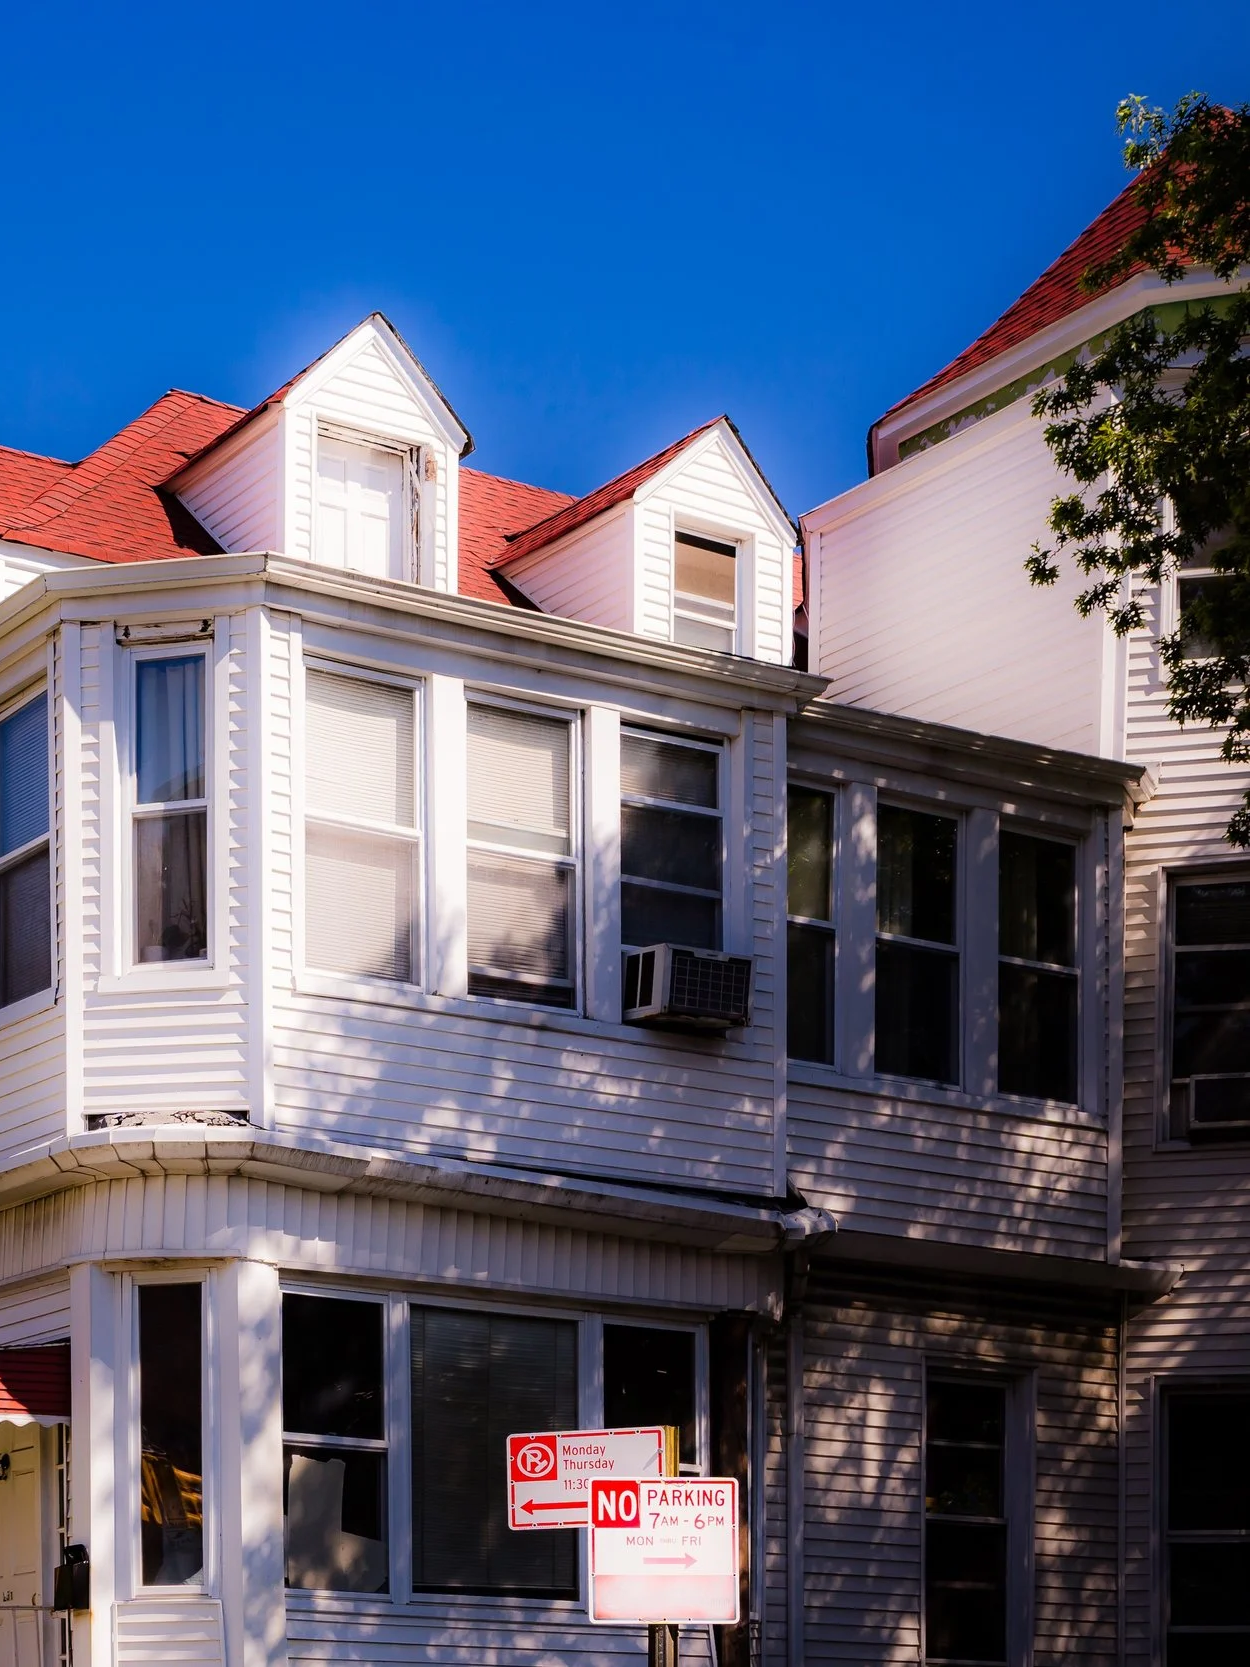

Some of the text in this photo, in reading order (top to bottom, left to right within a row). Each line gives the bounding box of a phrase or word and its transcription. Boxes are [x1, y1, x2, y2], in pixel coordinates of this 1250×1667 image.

[562, 1444, 606, 1457] Monday
[563, 1458, 615, 1471] Thursday
[597, 1489, 725, 1522] NO PARKING
[649, 1512, 679, 1530] 7AM
[694, 1513, 725, 1530] 6PM
[626, 1535, 654, 1546] MON
[681, 1535, 702, 1546] FRI
